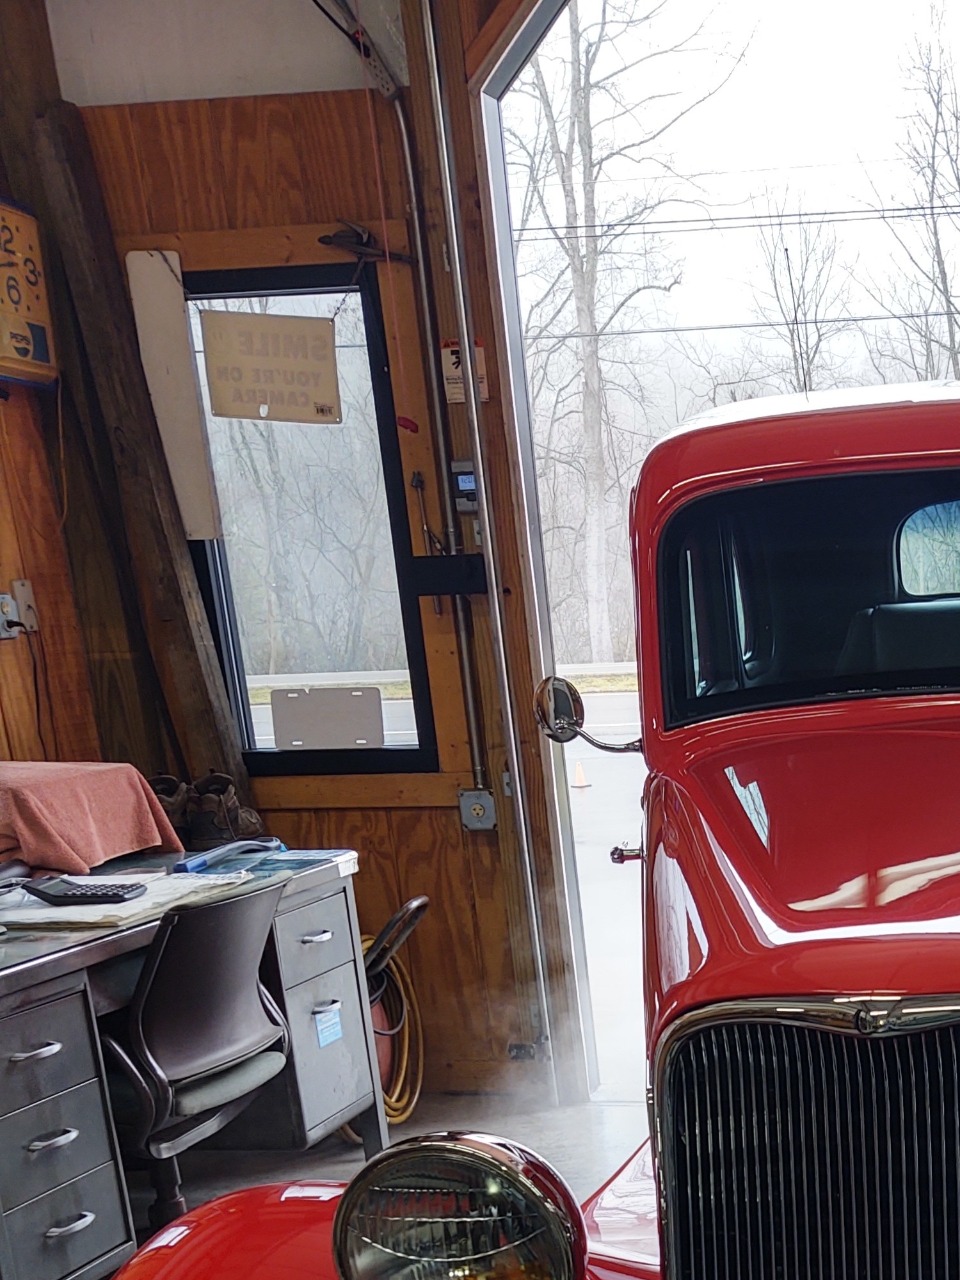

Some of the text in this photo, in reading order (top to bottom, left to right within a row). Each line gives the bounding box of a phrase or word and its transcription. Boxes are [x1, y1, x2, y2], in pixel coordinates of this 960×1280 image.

[0, 225, 16, 256] 2
[23, 257, 39, 287] 3
[6, 275, 21, 306] 6
